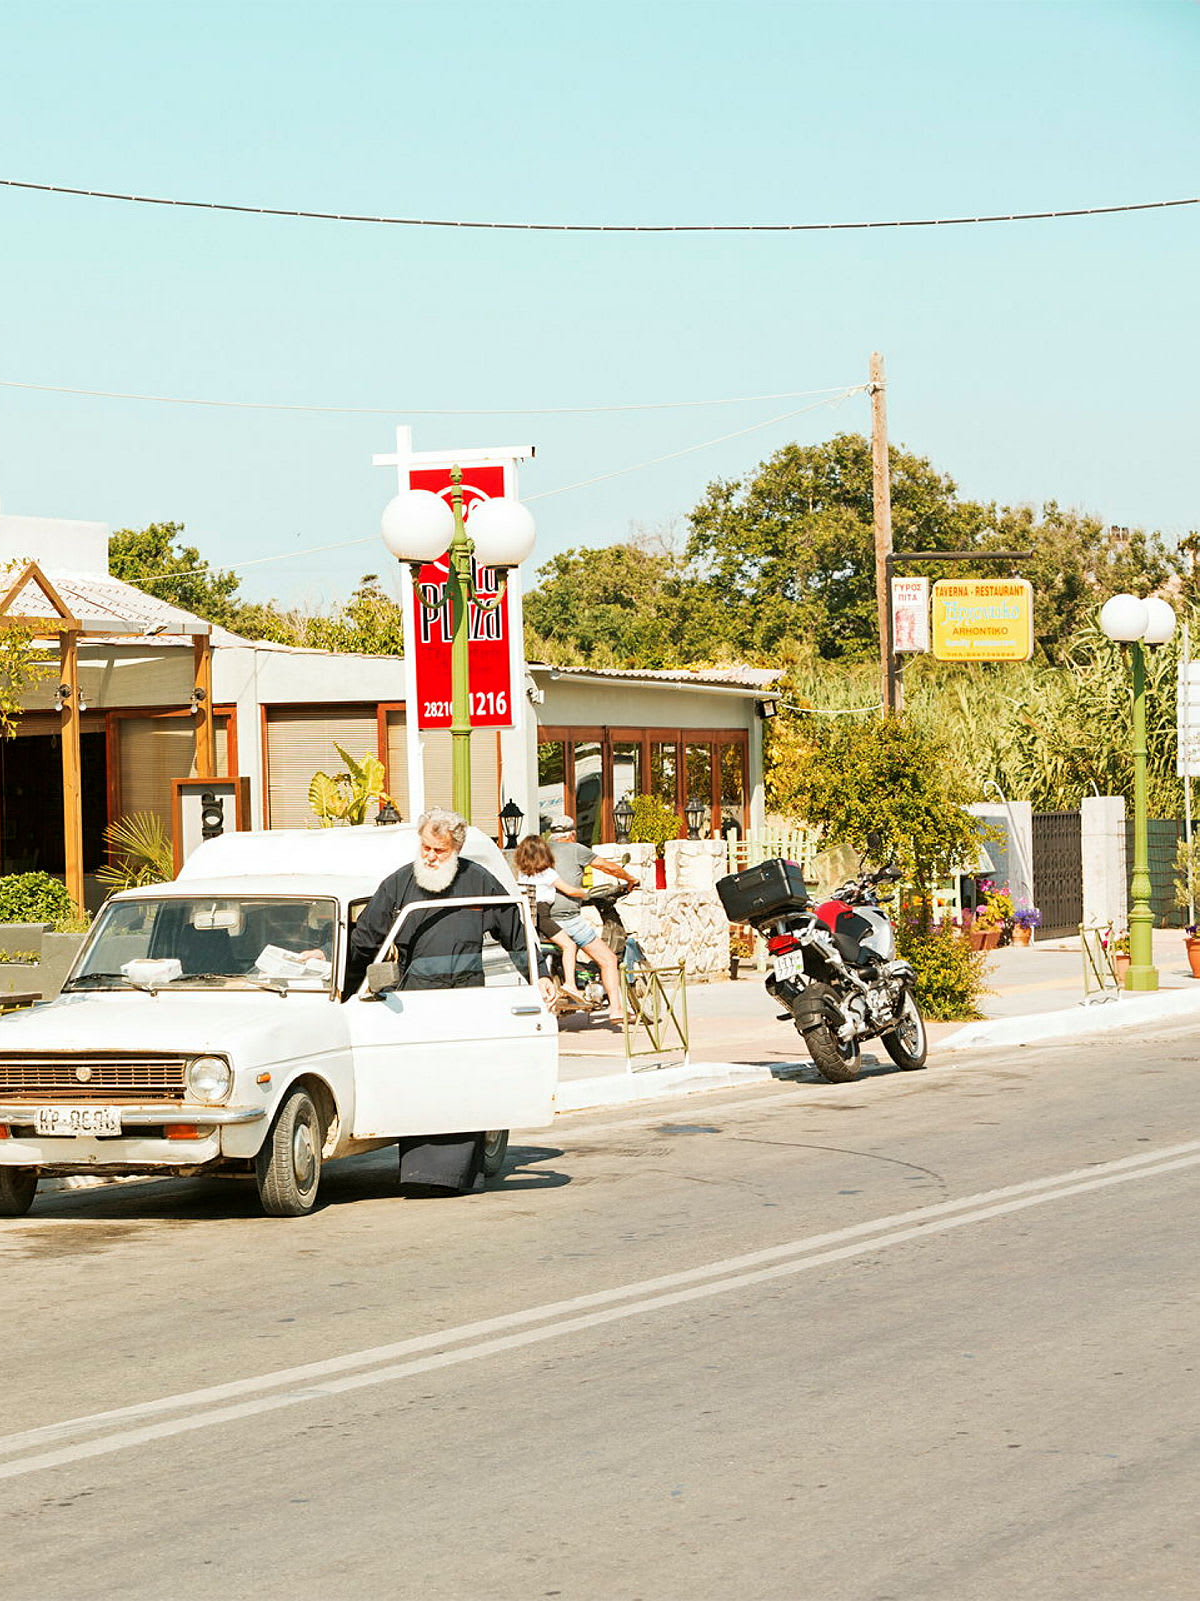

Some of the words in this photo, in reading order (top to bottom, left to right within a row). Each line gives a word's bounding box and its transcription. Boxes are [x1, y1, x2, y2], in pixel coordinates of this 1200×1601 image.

[935, 586, 968, 597] TAVERNA
[975, 585, 1024, 596] RESTAURANT
[952, 627, 1009, 636] ARHONTIKO
[468, 691, 507, 716] 1216
